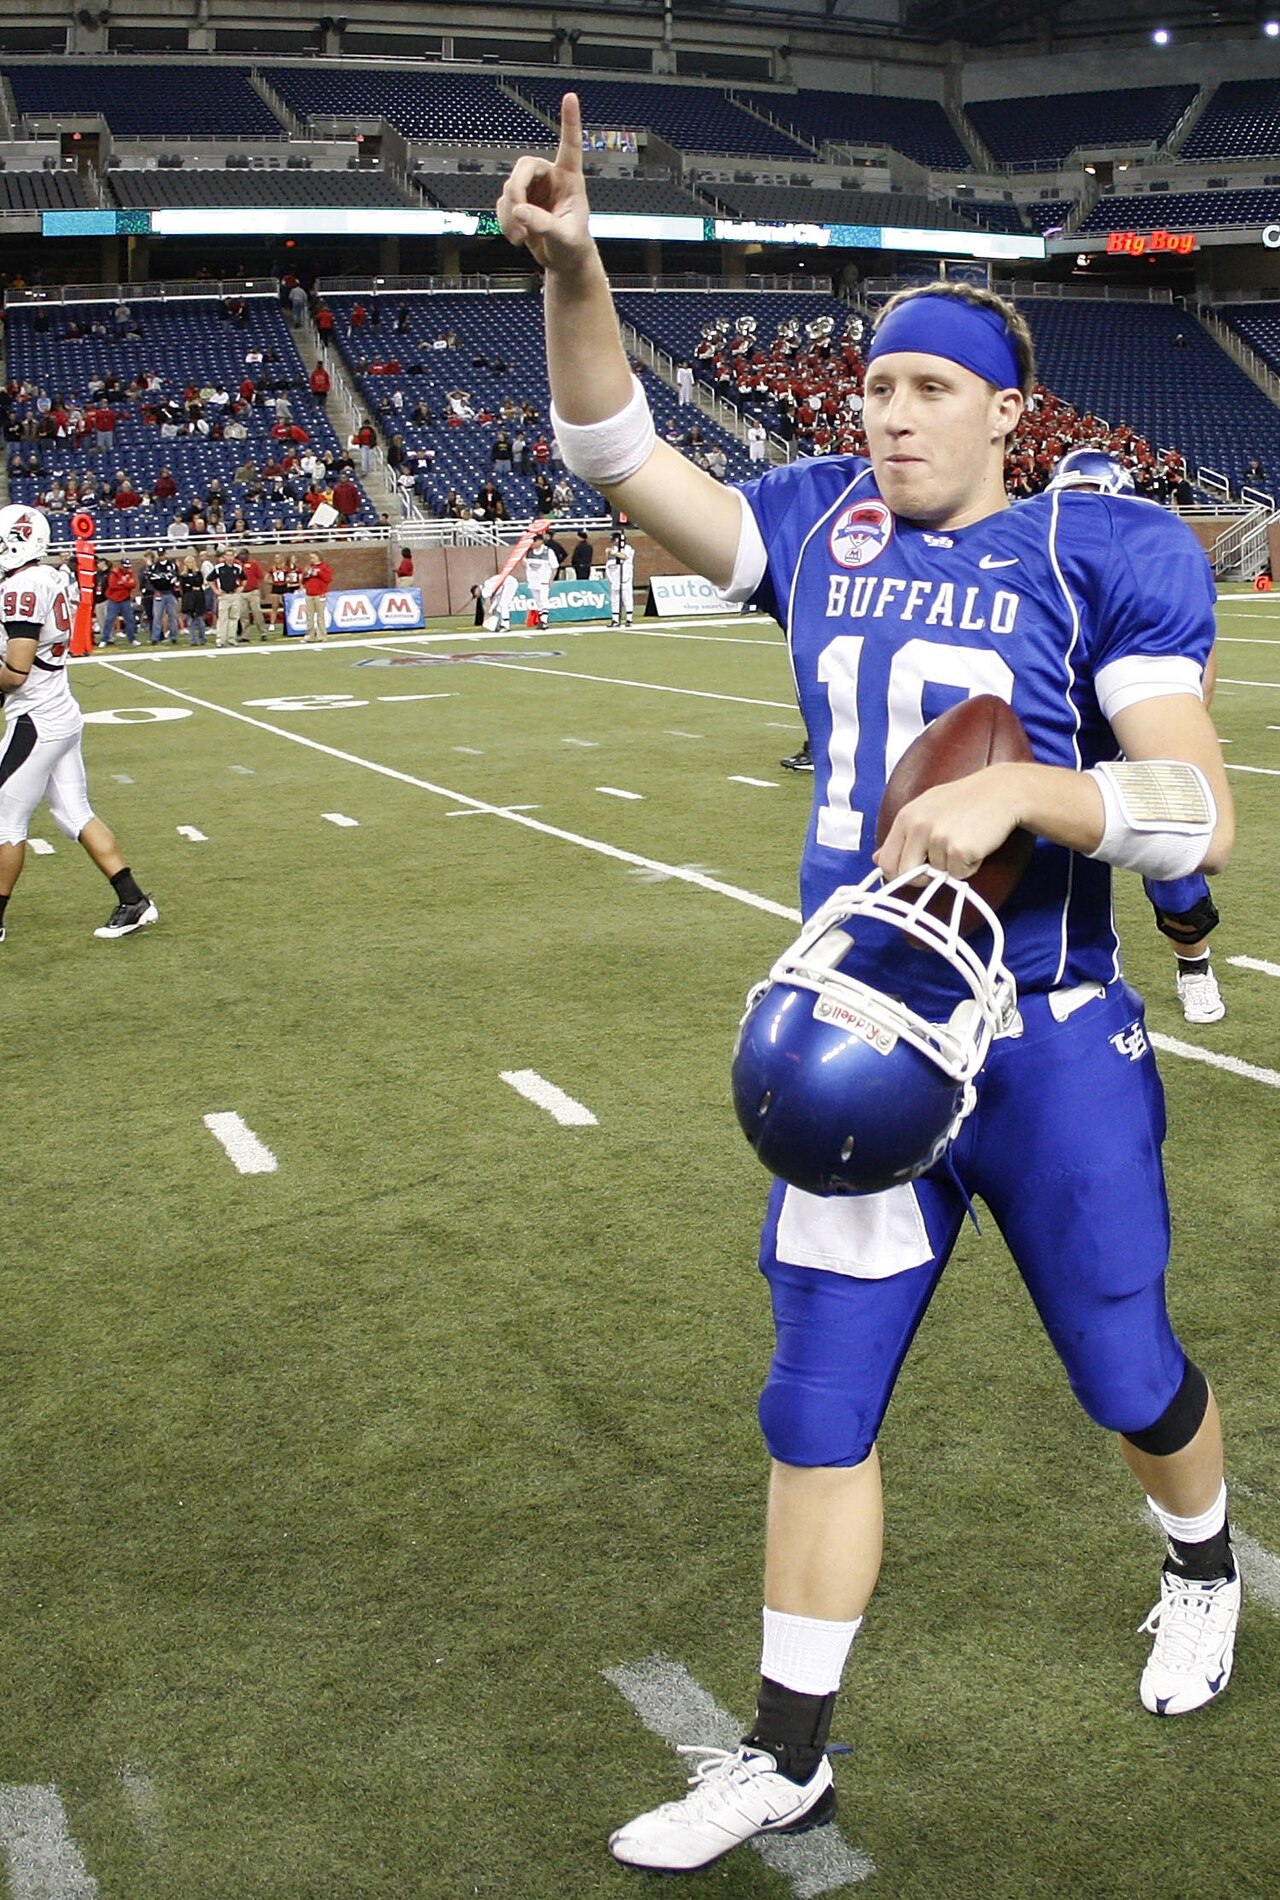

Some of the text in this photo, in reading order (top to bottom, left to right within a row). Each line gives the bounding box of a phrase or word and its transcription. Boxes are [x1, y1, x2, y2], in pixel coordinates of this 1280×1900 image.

[1107, 230, 1196, 256] Big Boy
[4, 592, 36, 617] 99
[825, 574, 1021, 634] BUFFALO
[832, 1006, 880, 1040] Riddell
